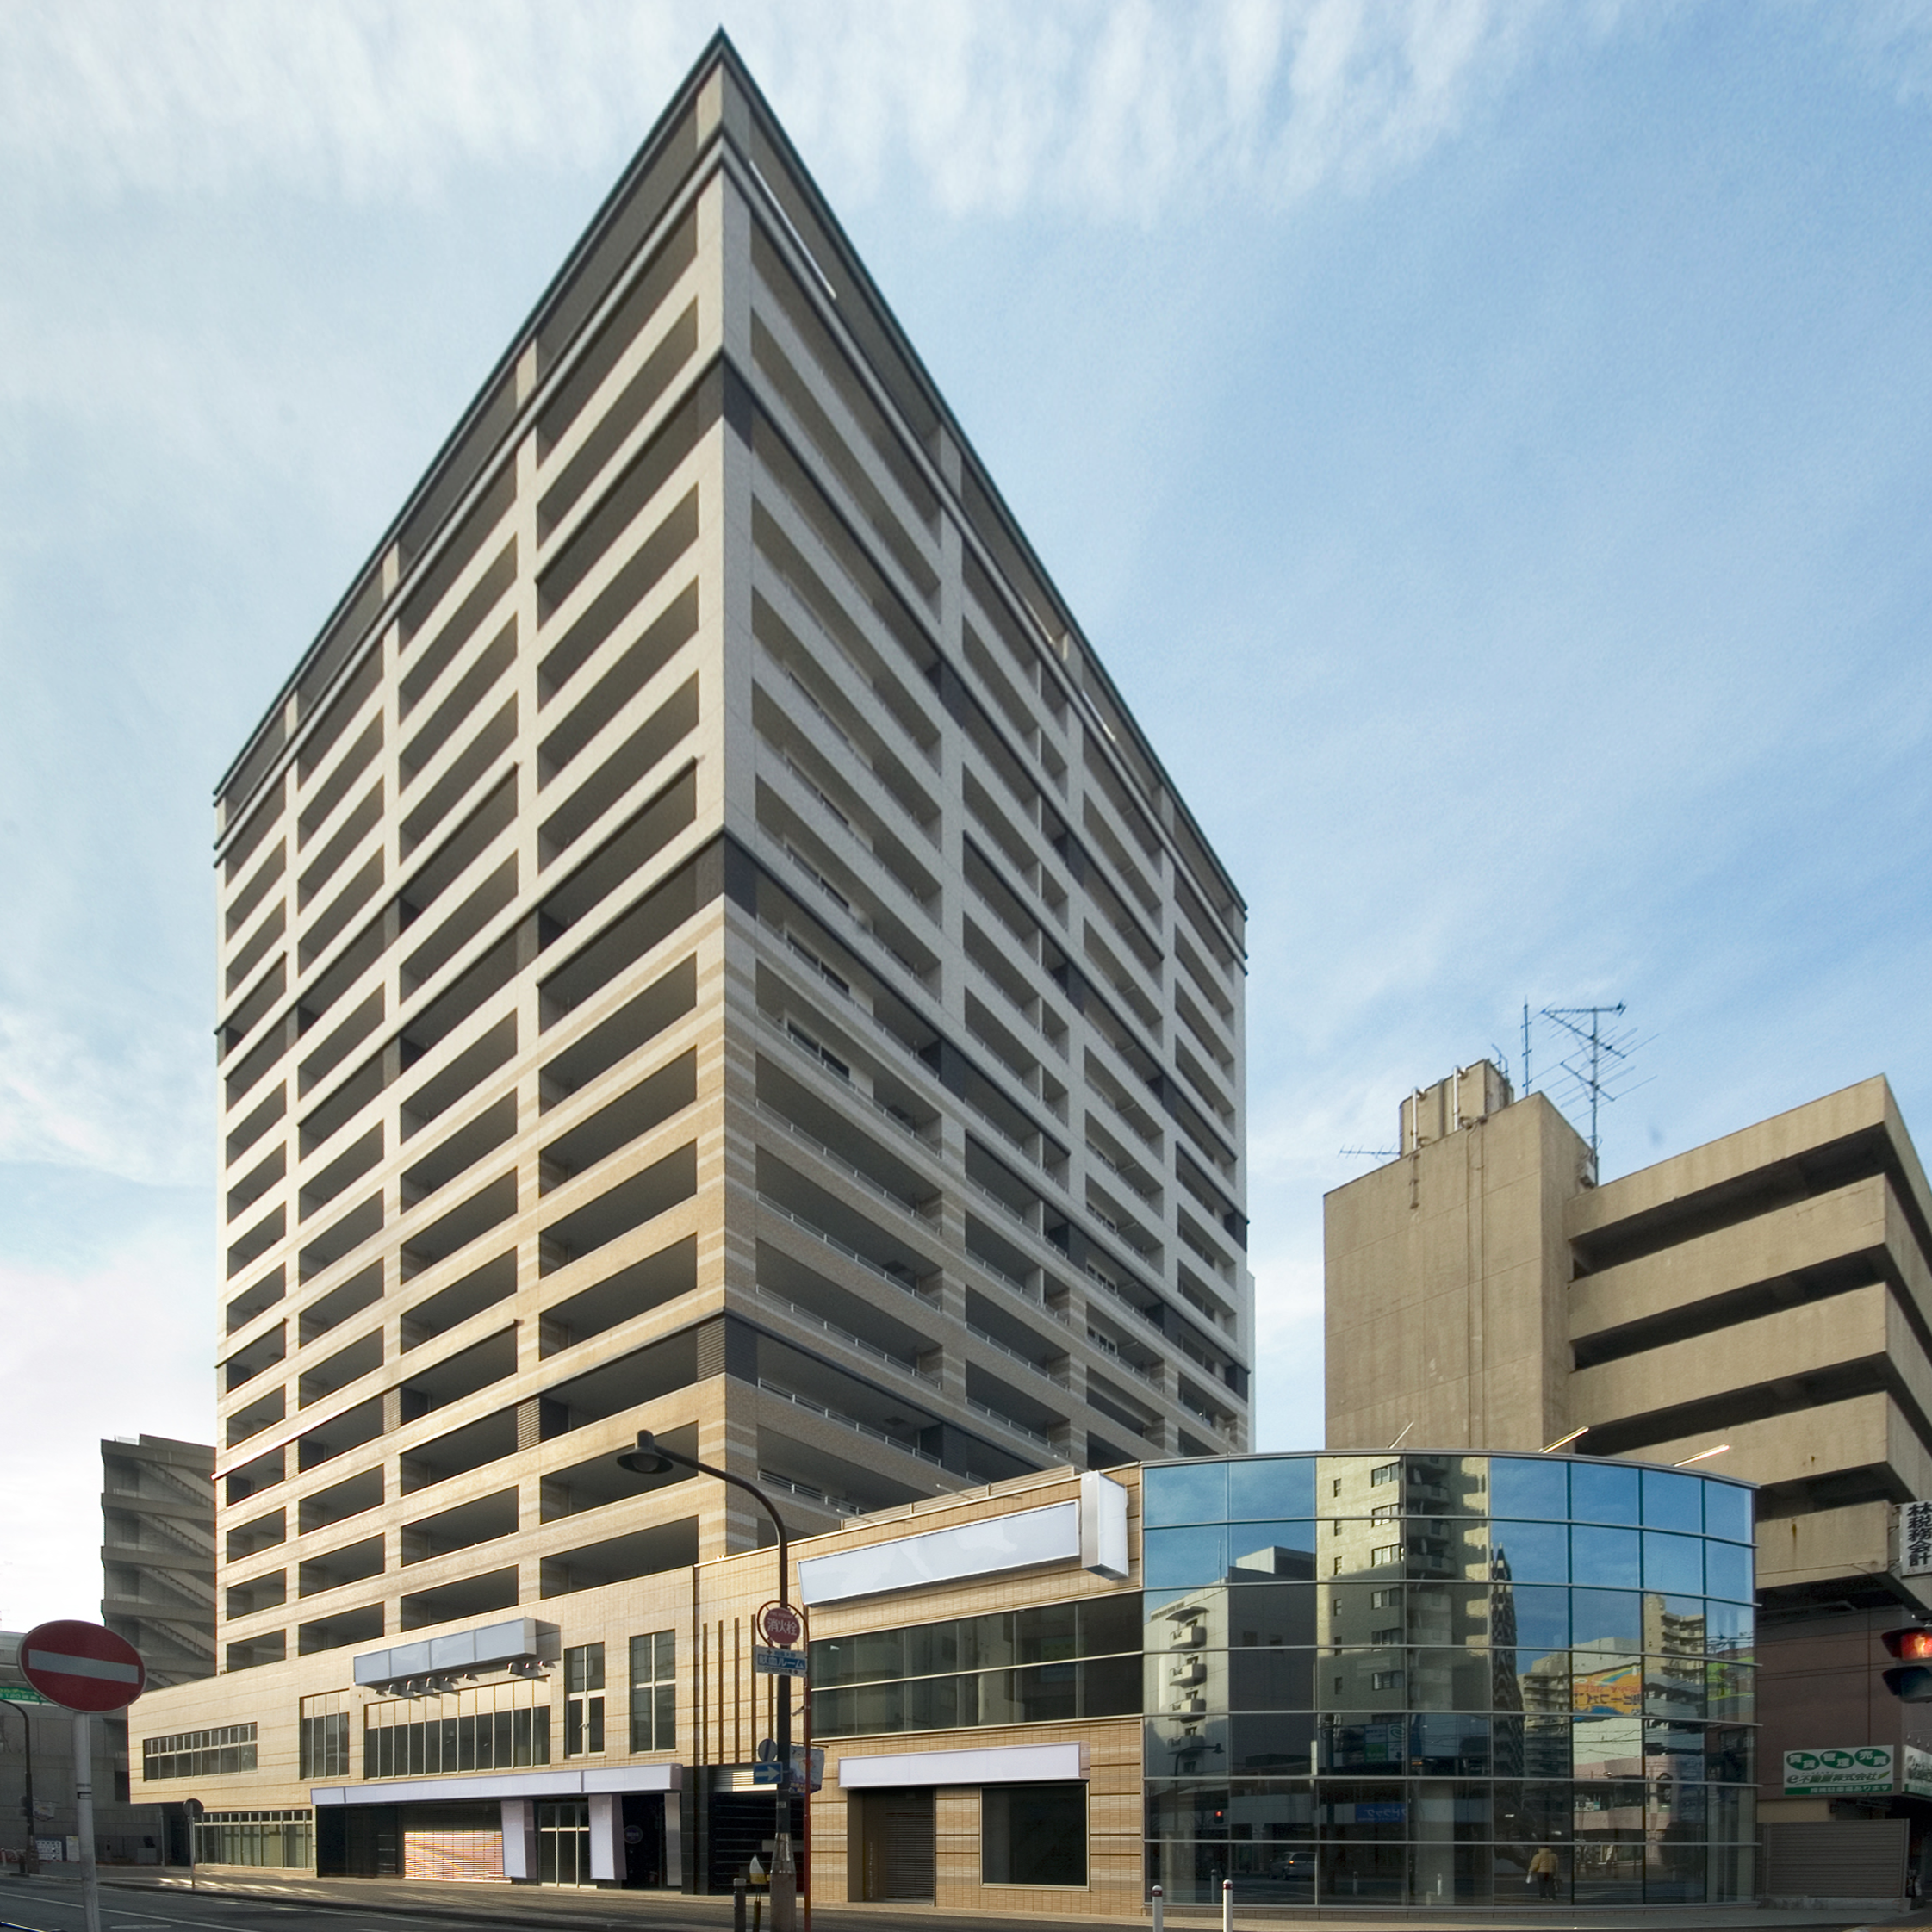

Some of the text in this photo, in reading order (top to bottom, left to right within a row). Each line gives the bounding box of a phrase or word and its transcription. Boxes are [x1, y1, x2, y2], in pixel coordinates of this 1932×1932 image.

[1906, 1501, 1932, 1567] 林税務会計
[767, 1618, 798, 1636] 消火栓
[758, 1655, 804, 1668] 献血ルーム
